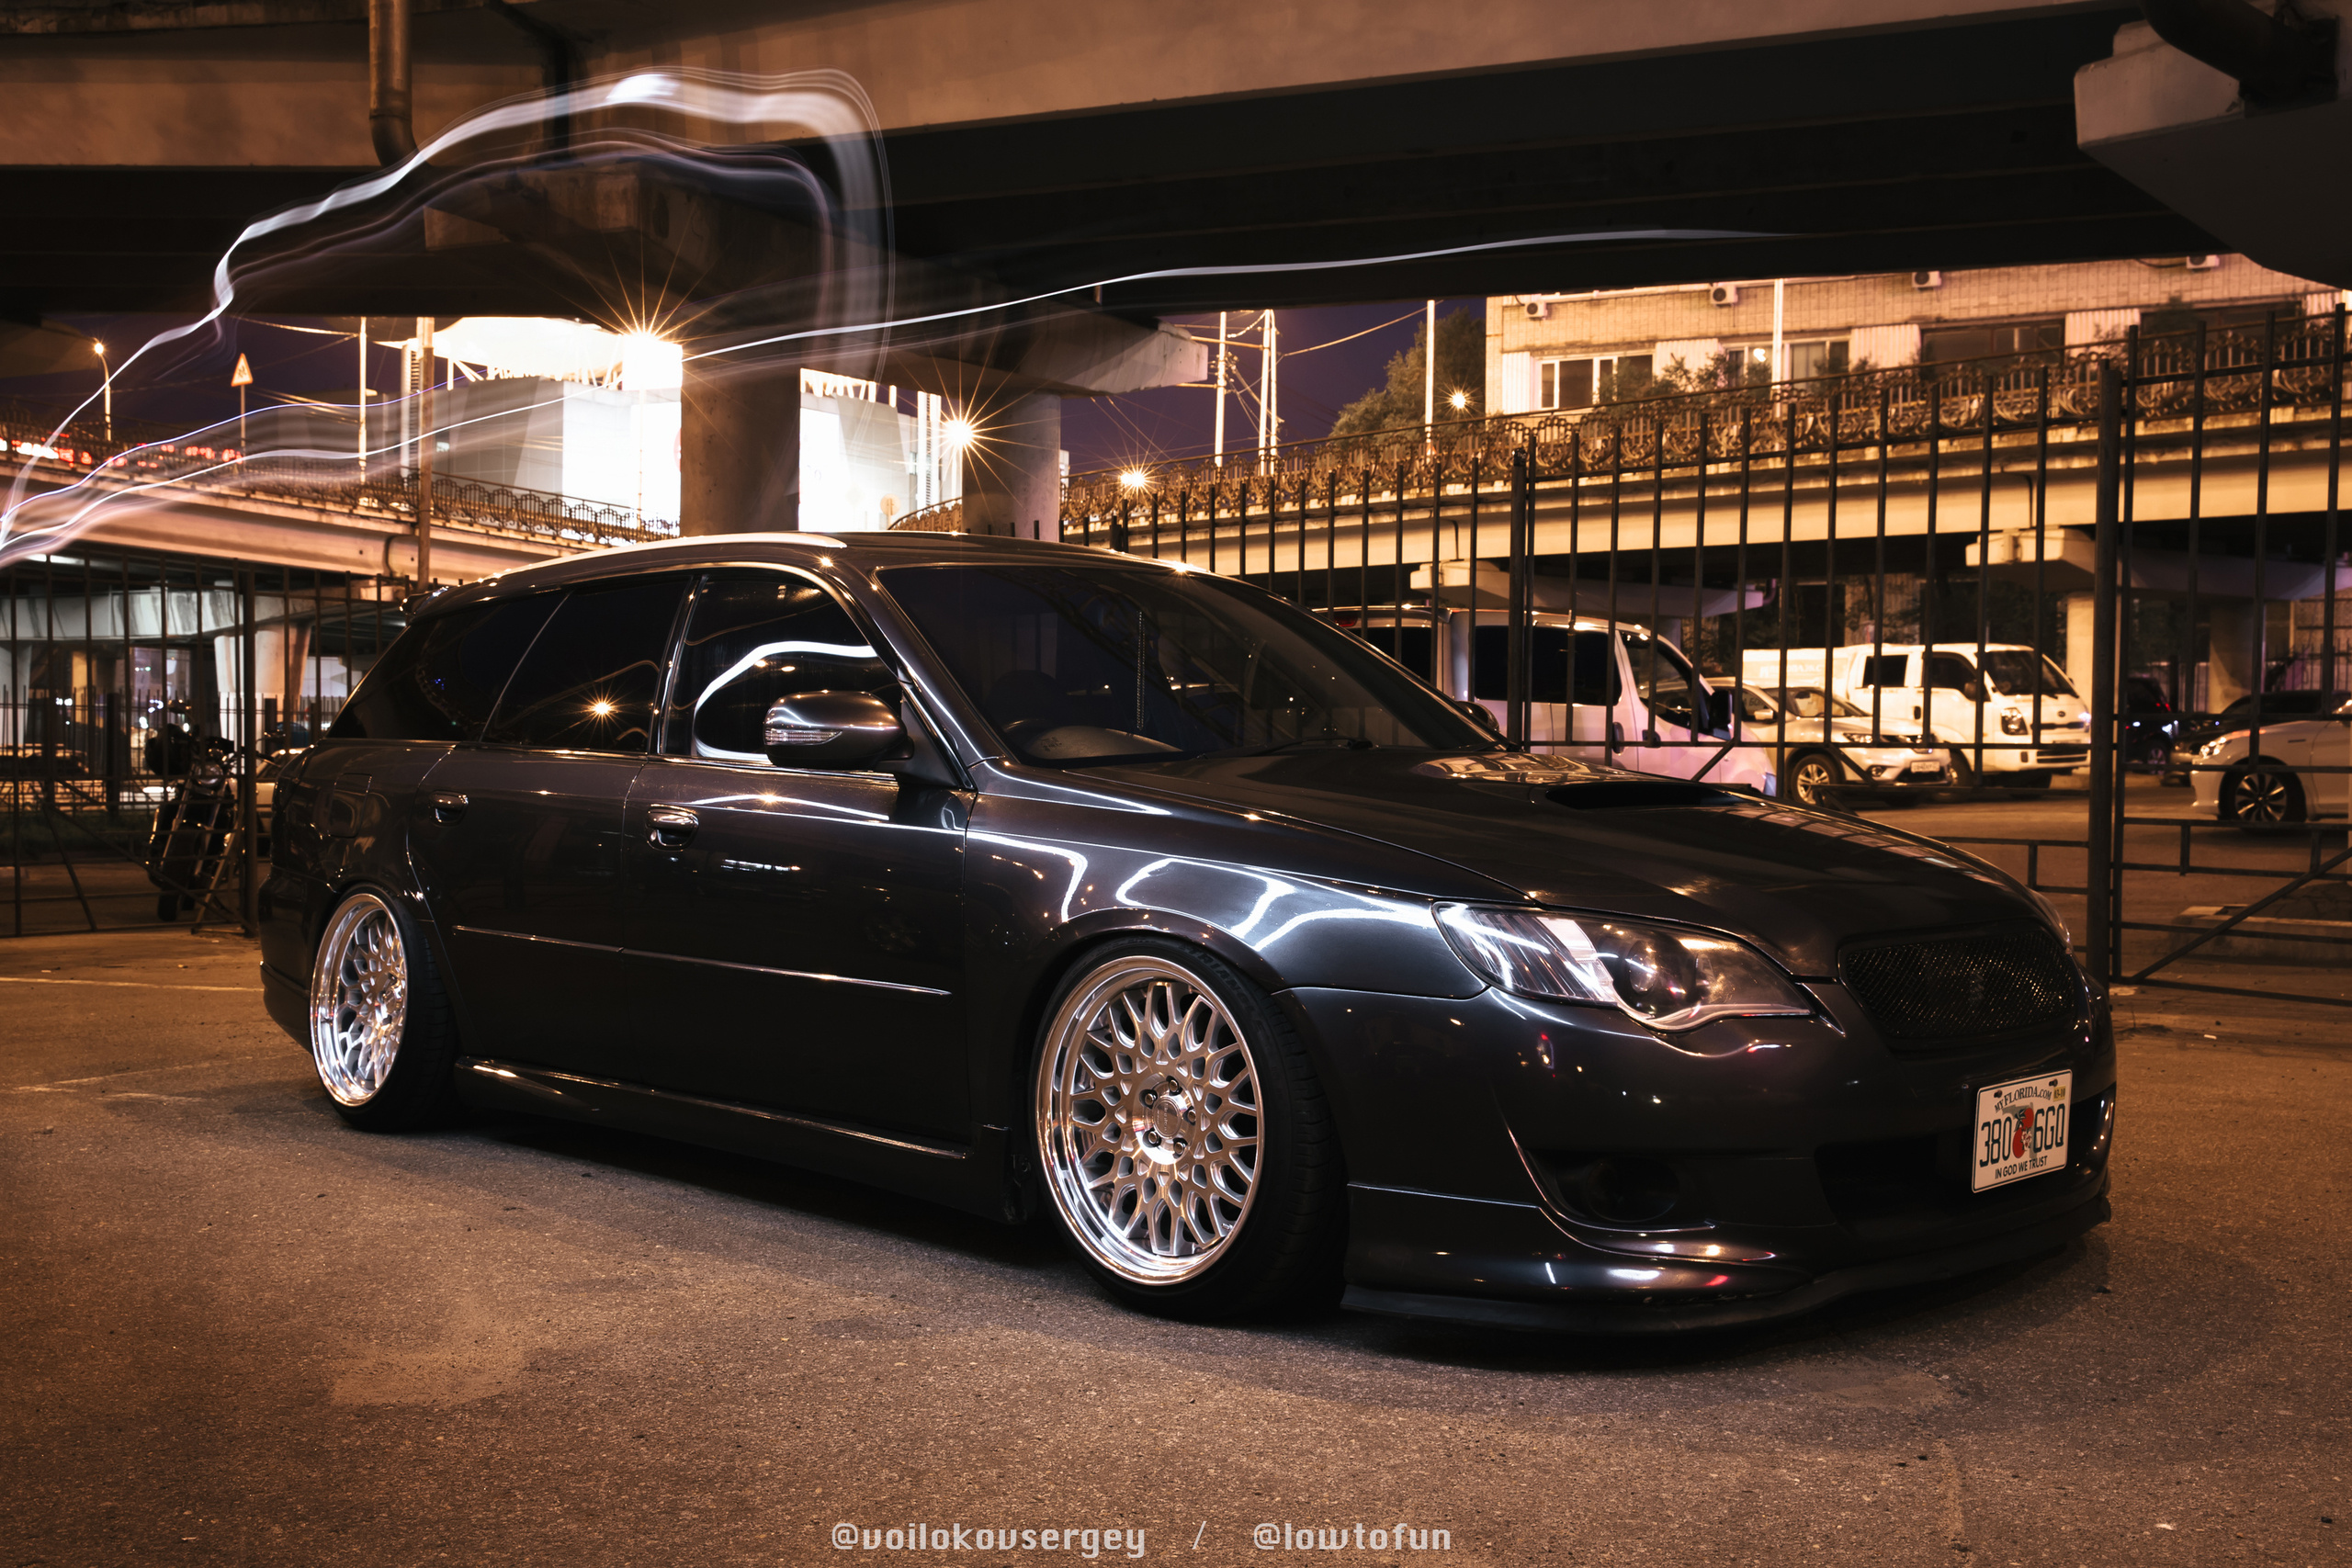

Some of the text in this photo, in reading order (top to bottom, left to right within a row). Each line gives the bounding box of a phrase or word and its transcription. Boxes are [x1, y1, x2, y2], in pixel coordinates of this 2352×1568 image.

[1979, 1116, 2012, 1168] 380
[1995, 1156, 2048, 1179] IN GOD WE TRUST
